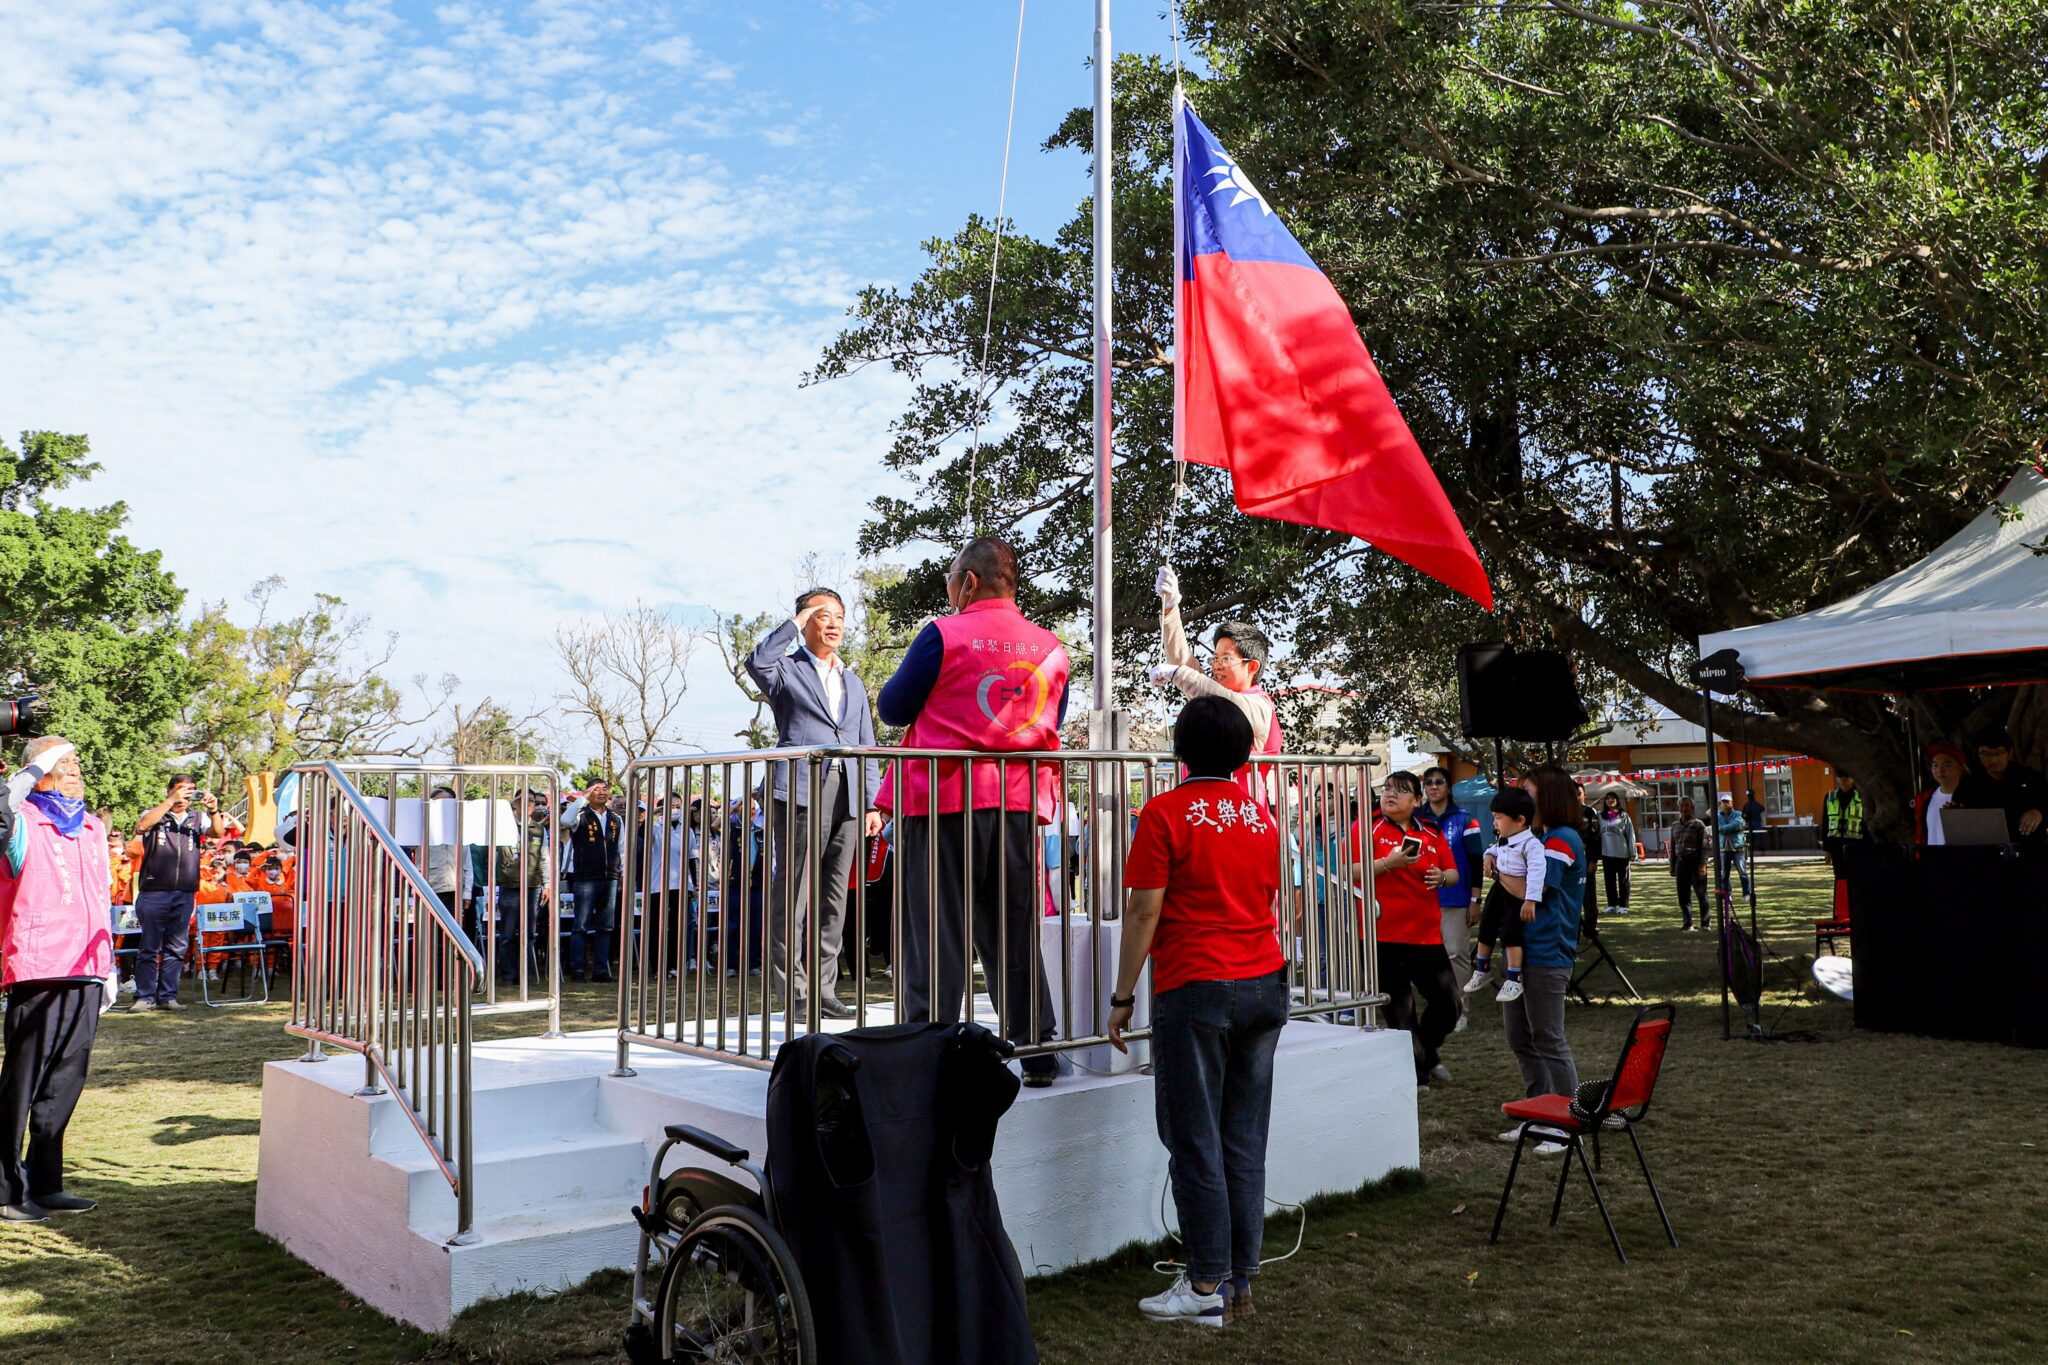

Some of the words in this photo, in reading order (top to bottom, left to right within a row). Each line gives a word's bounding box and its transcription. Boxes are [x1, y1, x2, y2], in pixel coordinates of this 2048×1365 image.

[1187, 797, 1265, 828] 艾樂健
[207, 910, 241, 922] 縣長席
